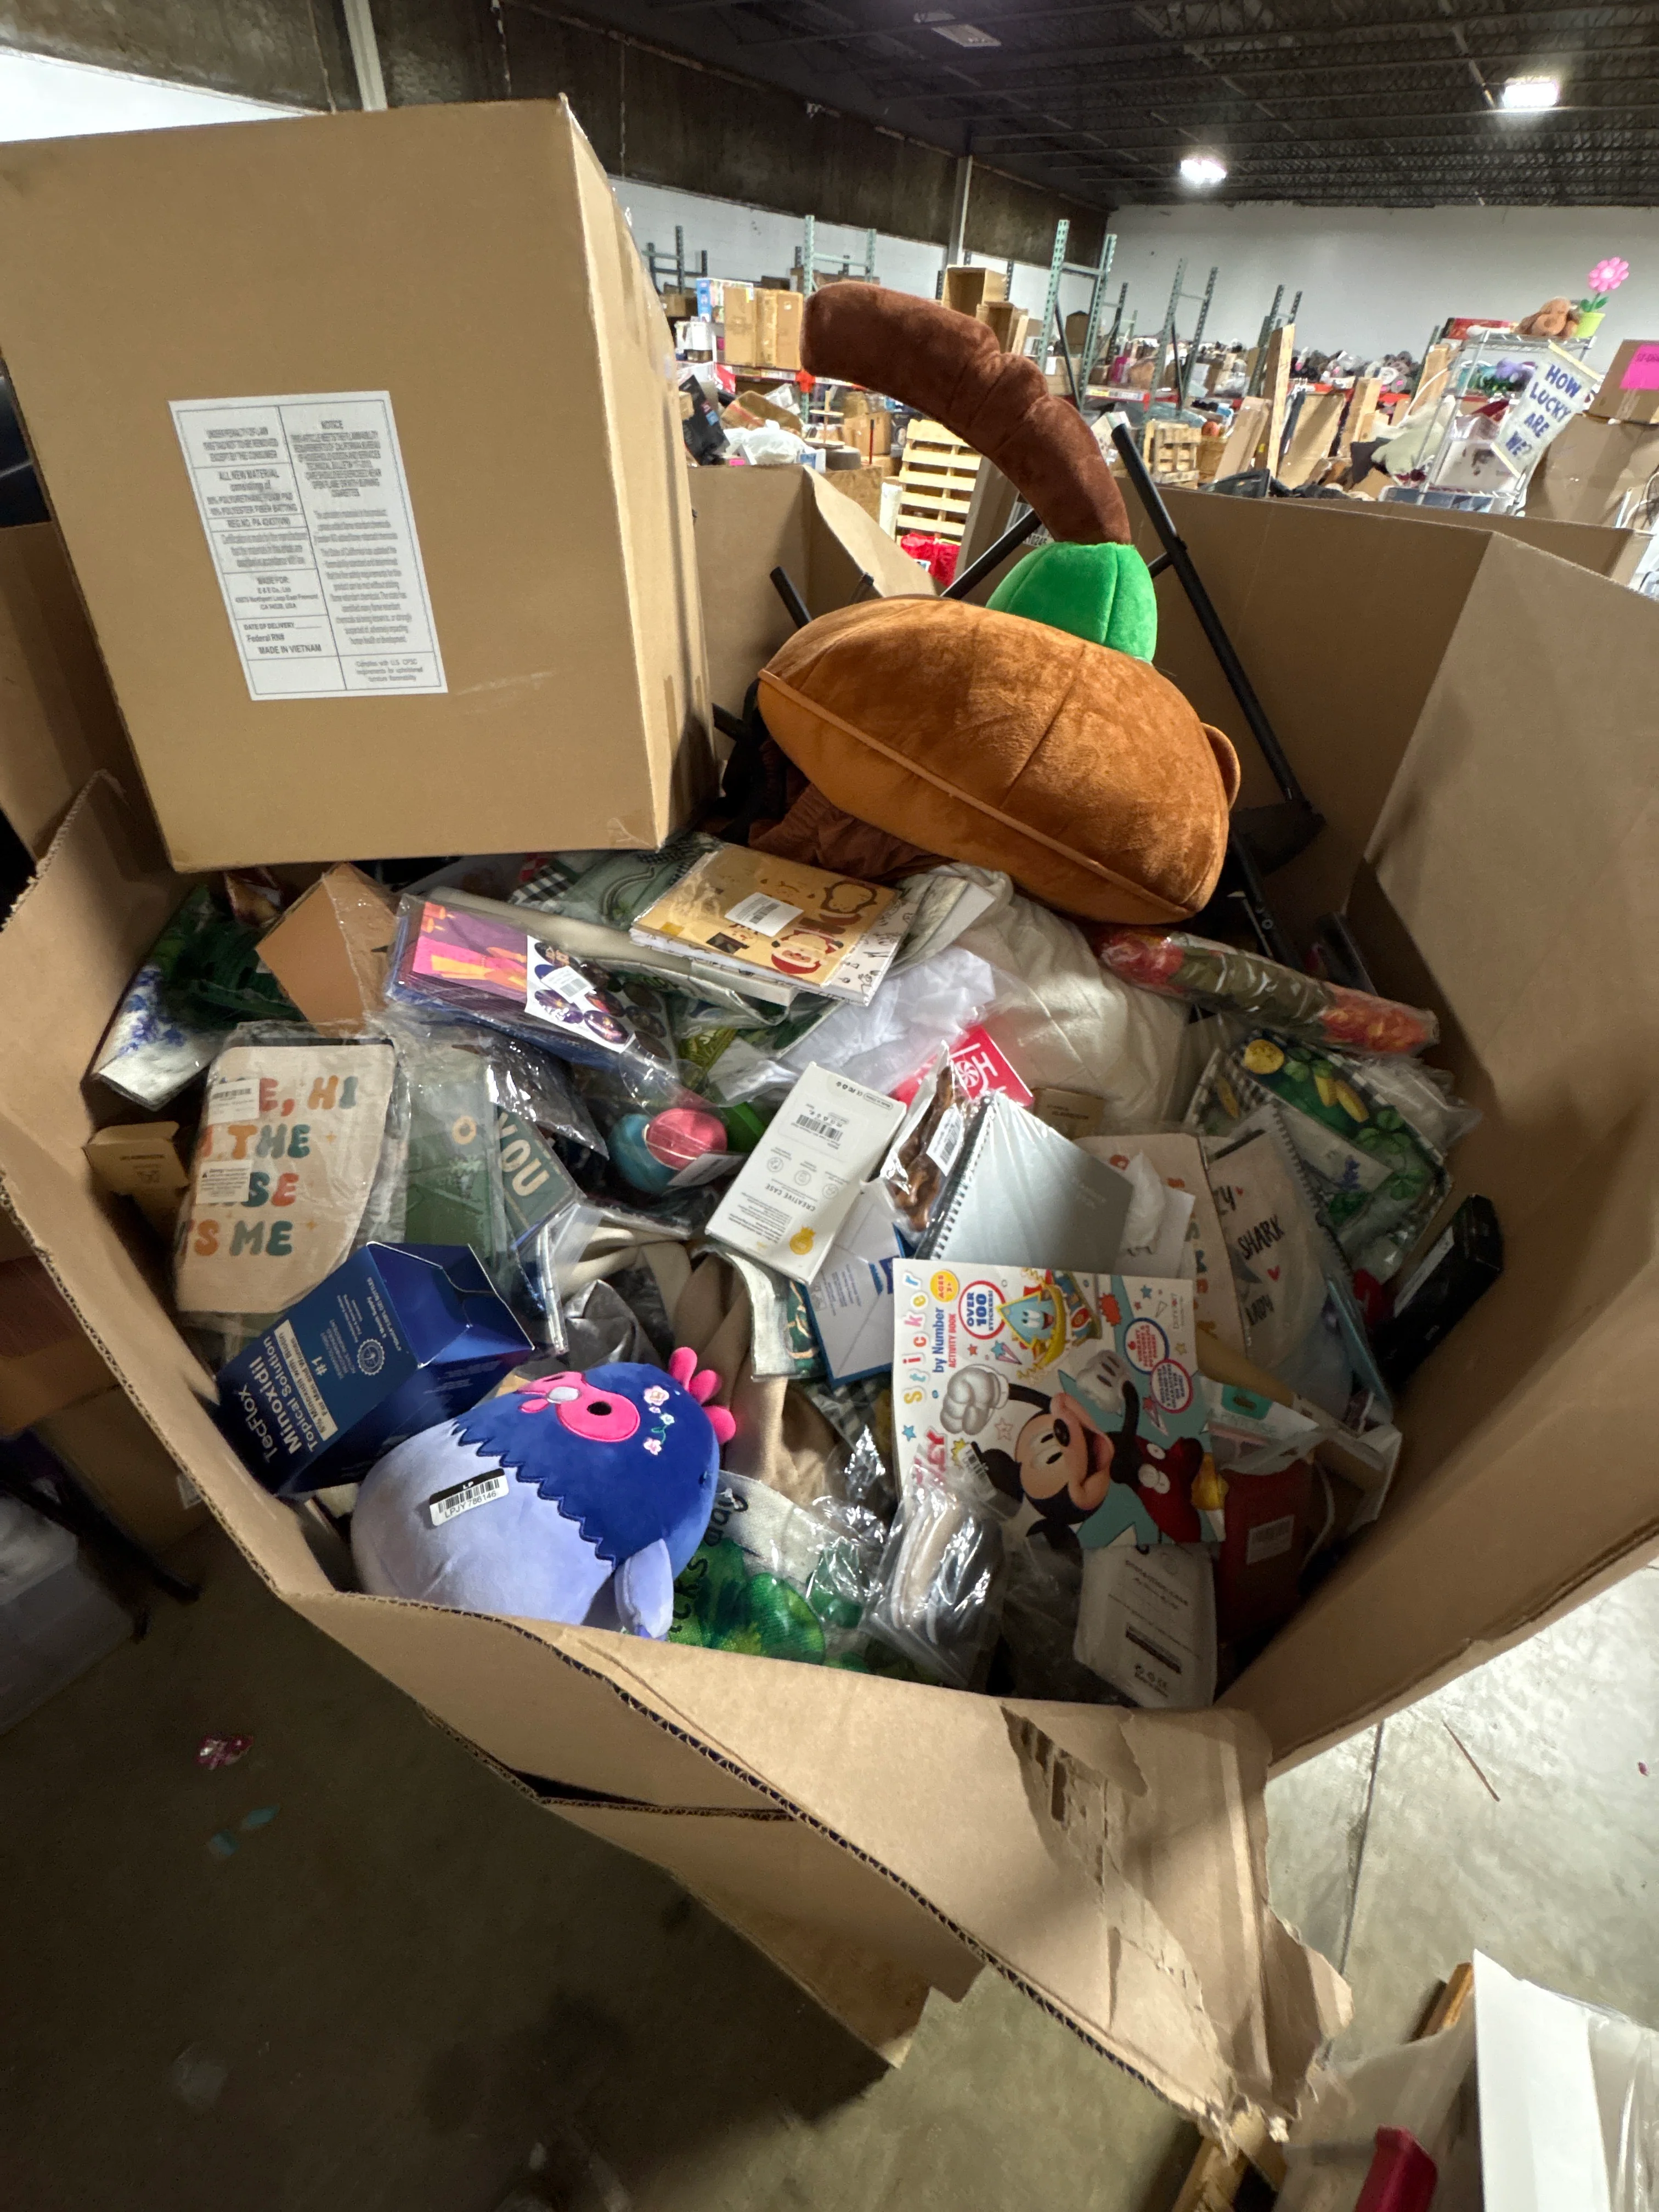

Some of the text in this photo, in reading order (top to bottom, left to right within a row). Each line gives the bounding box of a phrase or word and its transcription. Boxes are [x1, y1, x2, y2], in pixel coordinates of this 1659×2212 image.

[1545, 364, 1582, 398] HOW
[1530, 382, 1572, 422] LUCKY
[1523, 412, 1550, 438] ARE
[1505, 431, 1532, 456] WE?
[246, 634, 270, 642] Federal
[258, 646, 280, 654] MADE
[289, 644, 322, 653] VIETNAM
[307, 1075, 358, 1110] HI
[226, 1123, 311, 1159] THE
[498, 1112, 549, 1197] YOU
[765, 1183, 783, 1195] CASE
[783, 1192, 816, 1212] CREATIVE
[229, 1220, 294, 1257] ME
[1238, 1214, 1285, 1260] SHARK
[946, 1283, 952, 1292] 3+
[975, 1294, 987, 1327] 100
[903, 1274, 927, 1404] Sticker
[933, 1307, 947, 1373] by Number
[948, 1313, 957, 1369] ACTIVITY BOOK
[312, 1356, 328, 1376] #1
[249, 1356, 302, 1454] Minoxidil
[263, 1336, 318, 1453] Topical Solution
[238, 1382, 278, 1463] TecFlox
[462, 1481, 474, 1489] LP
[445, 1490, 496, 1518] LPJY 786146
